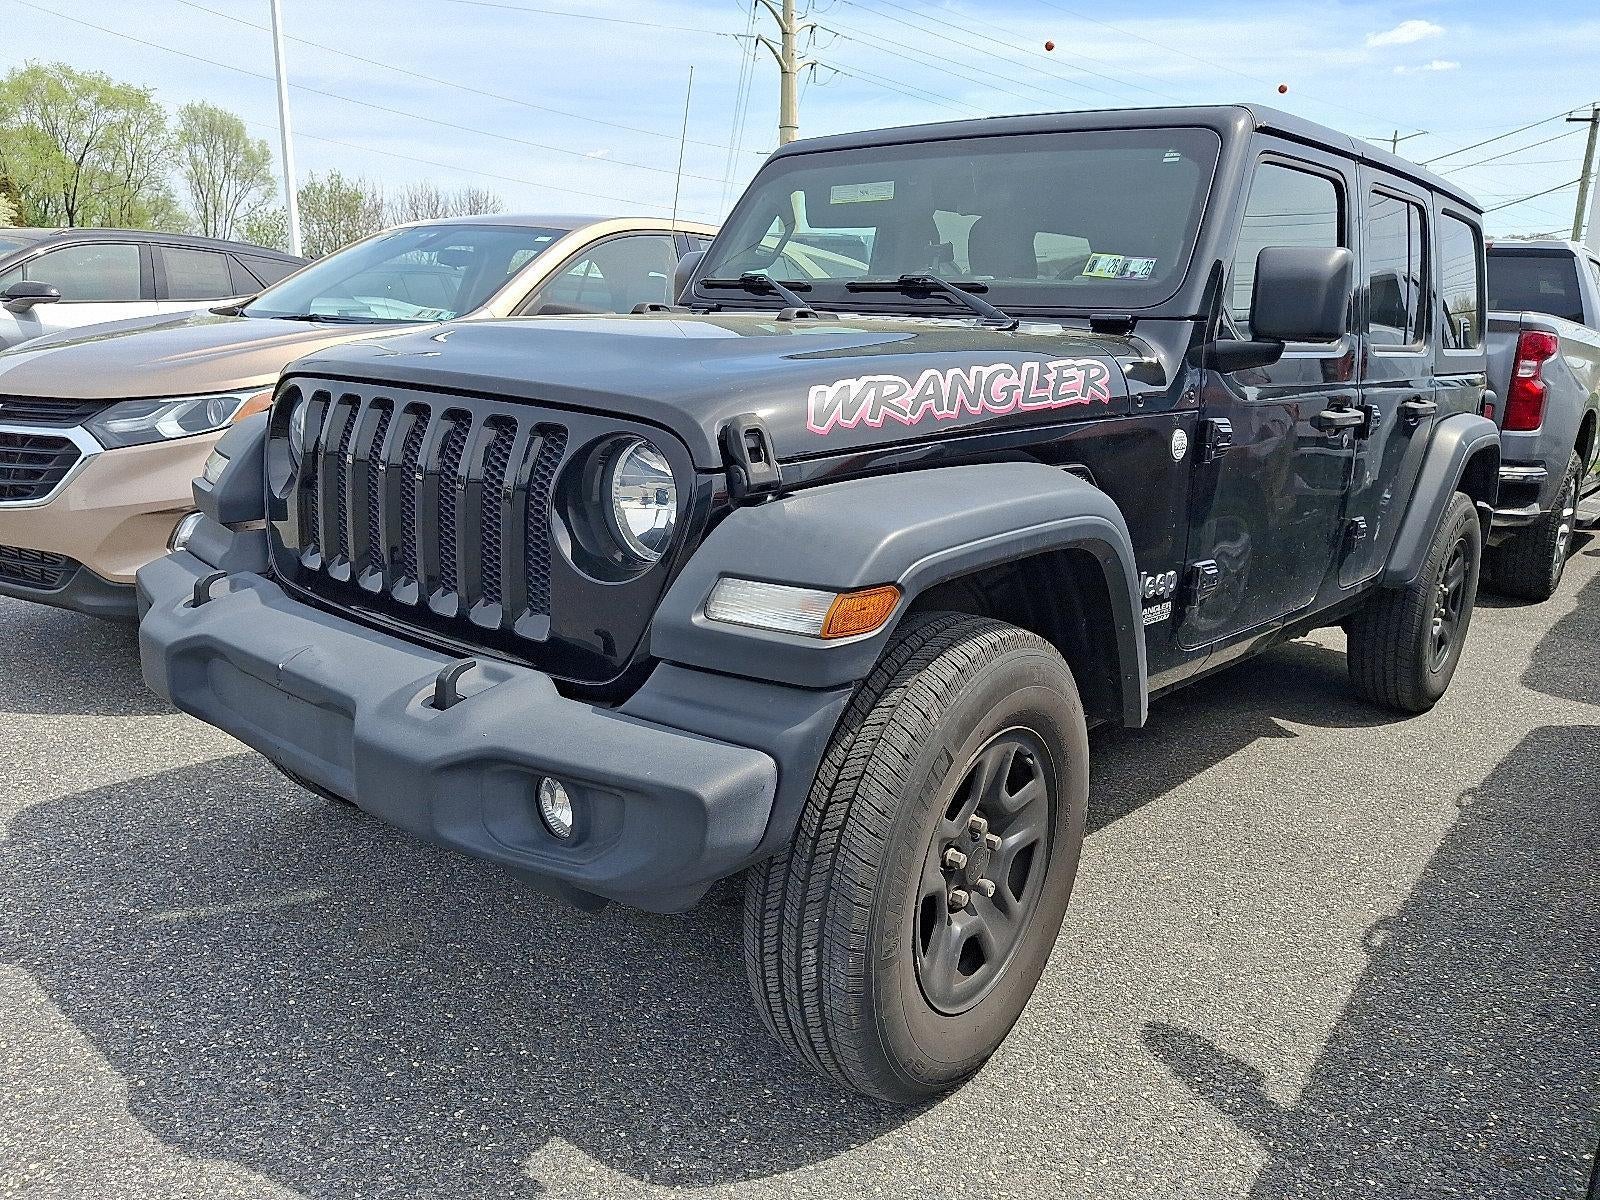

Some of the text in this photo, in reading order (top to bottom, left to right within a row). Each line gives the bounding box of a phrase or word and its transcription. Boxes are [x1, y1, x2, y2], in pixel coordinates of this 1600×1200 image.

[807, 359, 1109, 435] WRANGLER
[1140, 570, 1178, 599] Jeep
[1142, 601, 1172, 616] ANGLER
